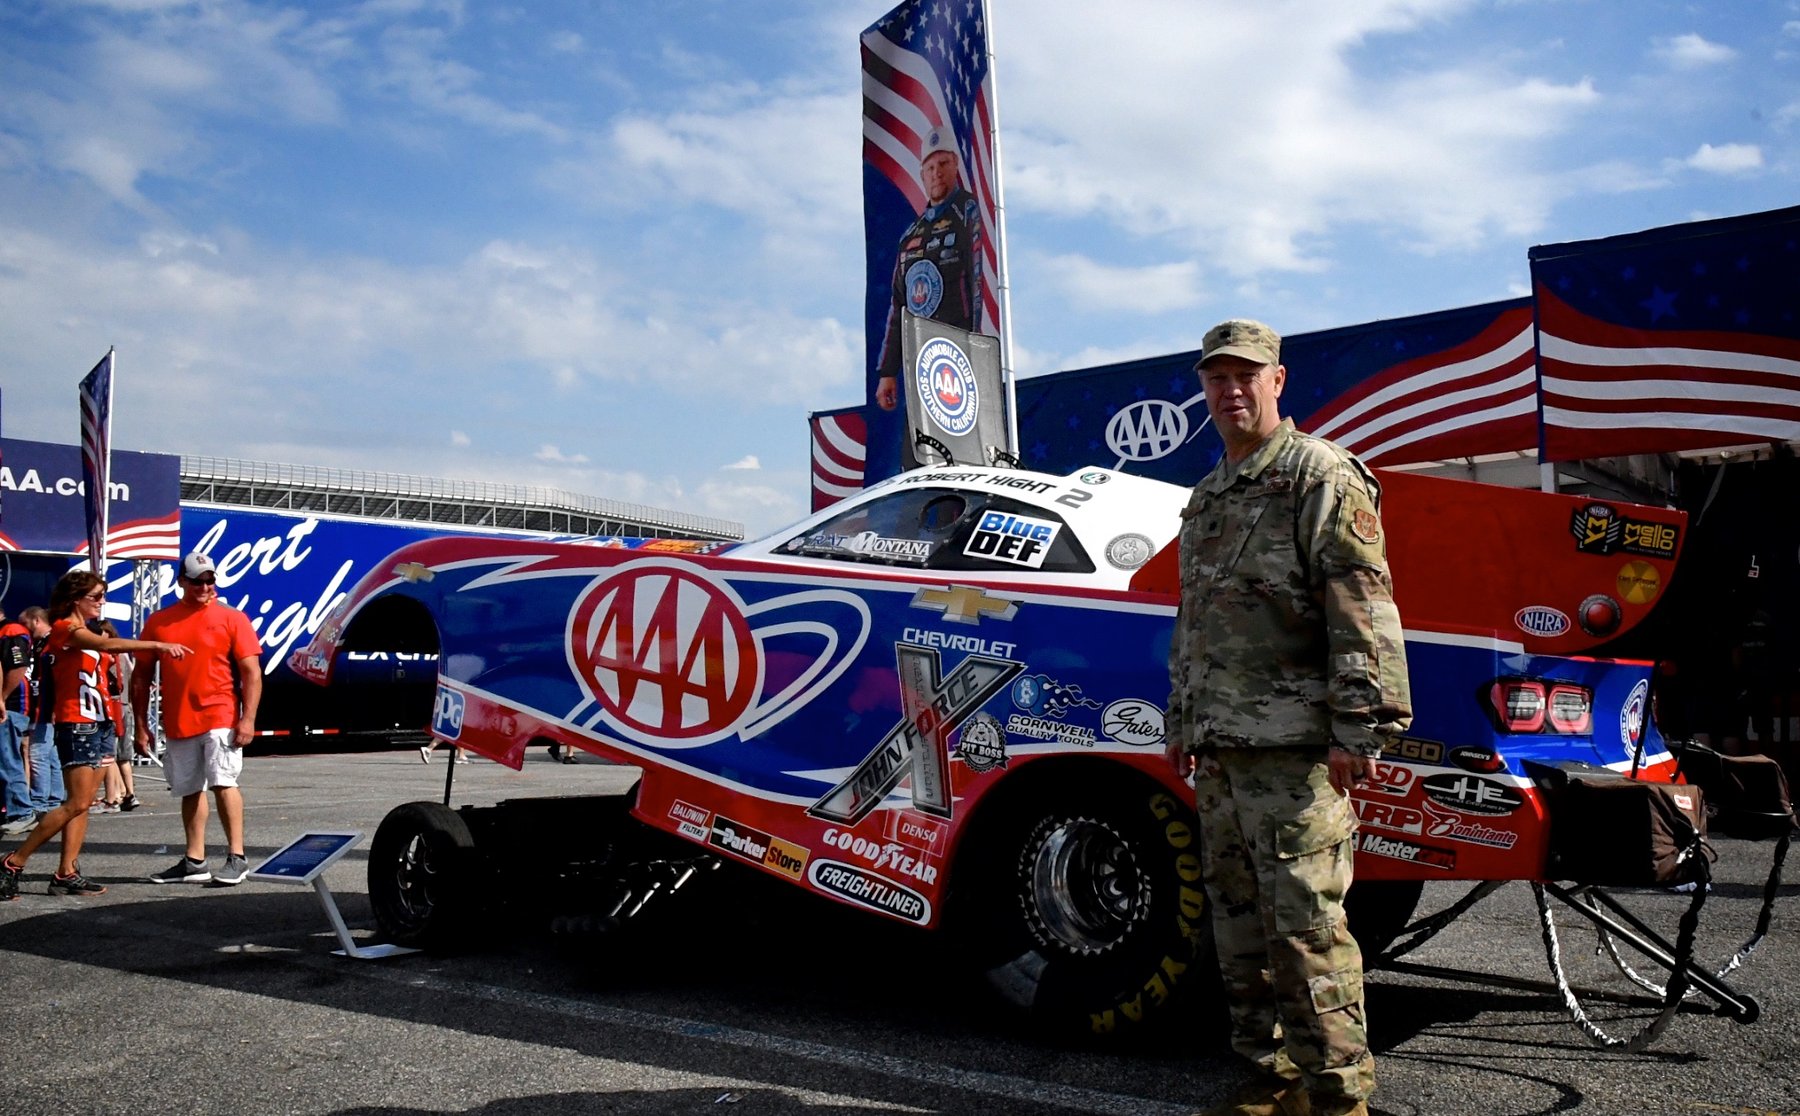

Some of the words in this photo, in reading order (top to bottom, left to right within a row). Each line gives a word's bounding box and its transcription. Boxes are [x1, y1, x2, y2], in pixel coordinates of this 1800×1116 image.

[921, 344, 959, 372] AUTOMOBILE
[957, 357, 973, 384] CLUB
[935, 372, 962, 397] AAA
[920, 376, 951, 429] SOUTHERN
[951, 391, 976, 431] CALIFORNIA
[1114, 402, 1181, 458] AAA
[0, 466, 130, 501] AA.cm
[898, 473, 986, 485] ROBERT
[986, 475, 1057, 495] HIGHT
[1054, 488, 1094, 509] 2
[1590, 505, 1609, 517] NHRA
[980, 513, 1053, 541] Blue
[851, 531, 930, 557] MONTANA
[967, 531, 1046, 562] DEF
[1523, 611, 1562, 632] NHRA
[584, 572, 732, 730] AAA
[903, 627, 1017, 659] CHEVROLET
[1007, 725, 1053, 741] QUALITY
[1058, 732, 1095, 747] TOOLS
[1009, 715, 1095, 740] CORNWELL
[1106, 706, 1164, 738] Gates
[849, 739, 904, 809] JOHN
[903, 664, 979, 752] FRCE
[961, 742, 977, 753] PIT
[979, 746, 1002, 759] BOSS
[1460, 750, 1491, 761] JOHNSEN'S
[1436, 776, 1513, 804] JHE
[672, 804, 706, 824] BALDWIN
[1427, 807, 1517, 844] Boninfante
[682, 823, 705, 837] FILTERS
[901, 821, 938, 843] DENSO
[819, 866, 924, 918] FREIGHTLINER
